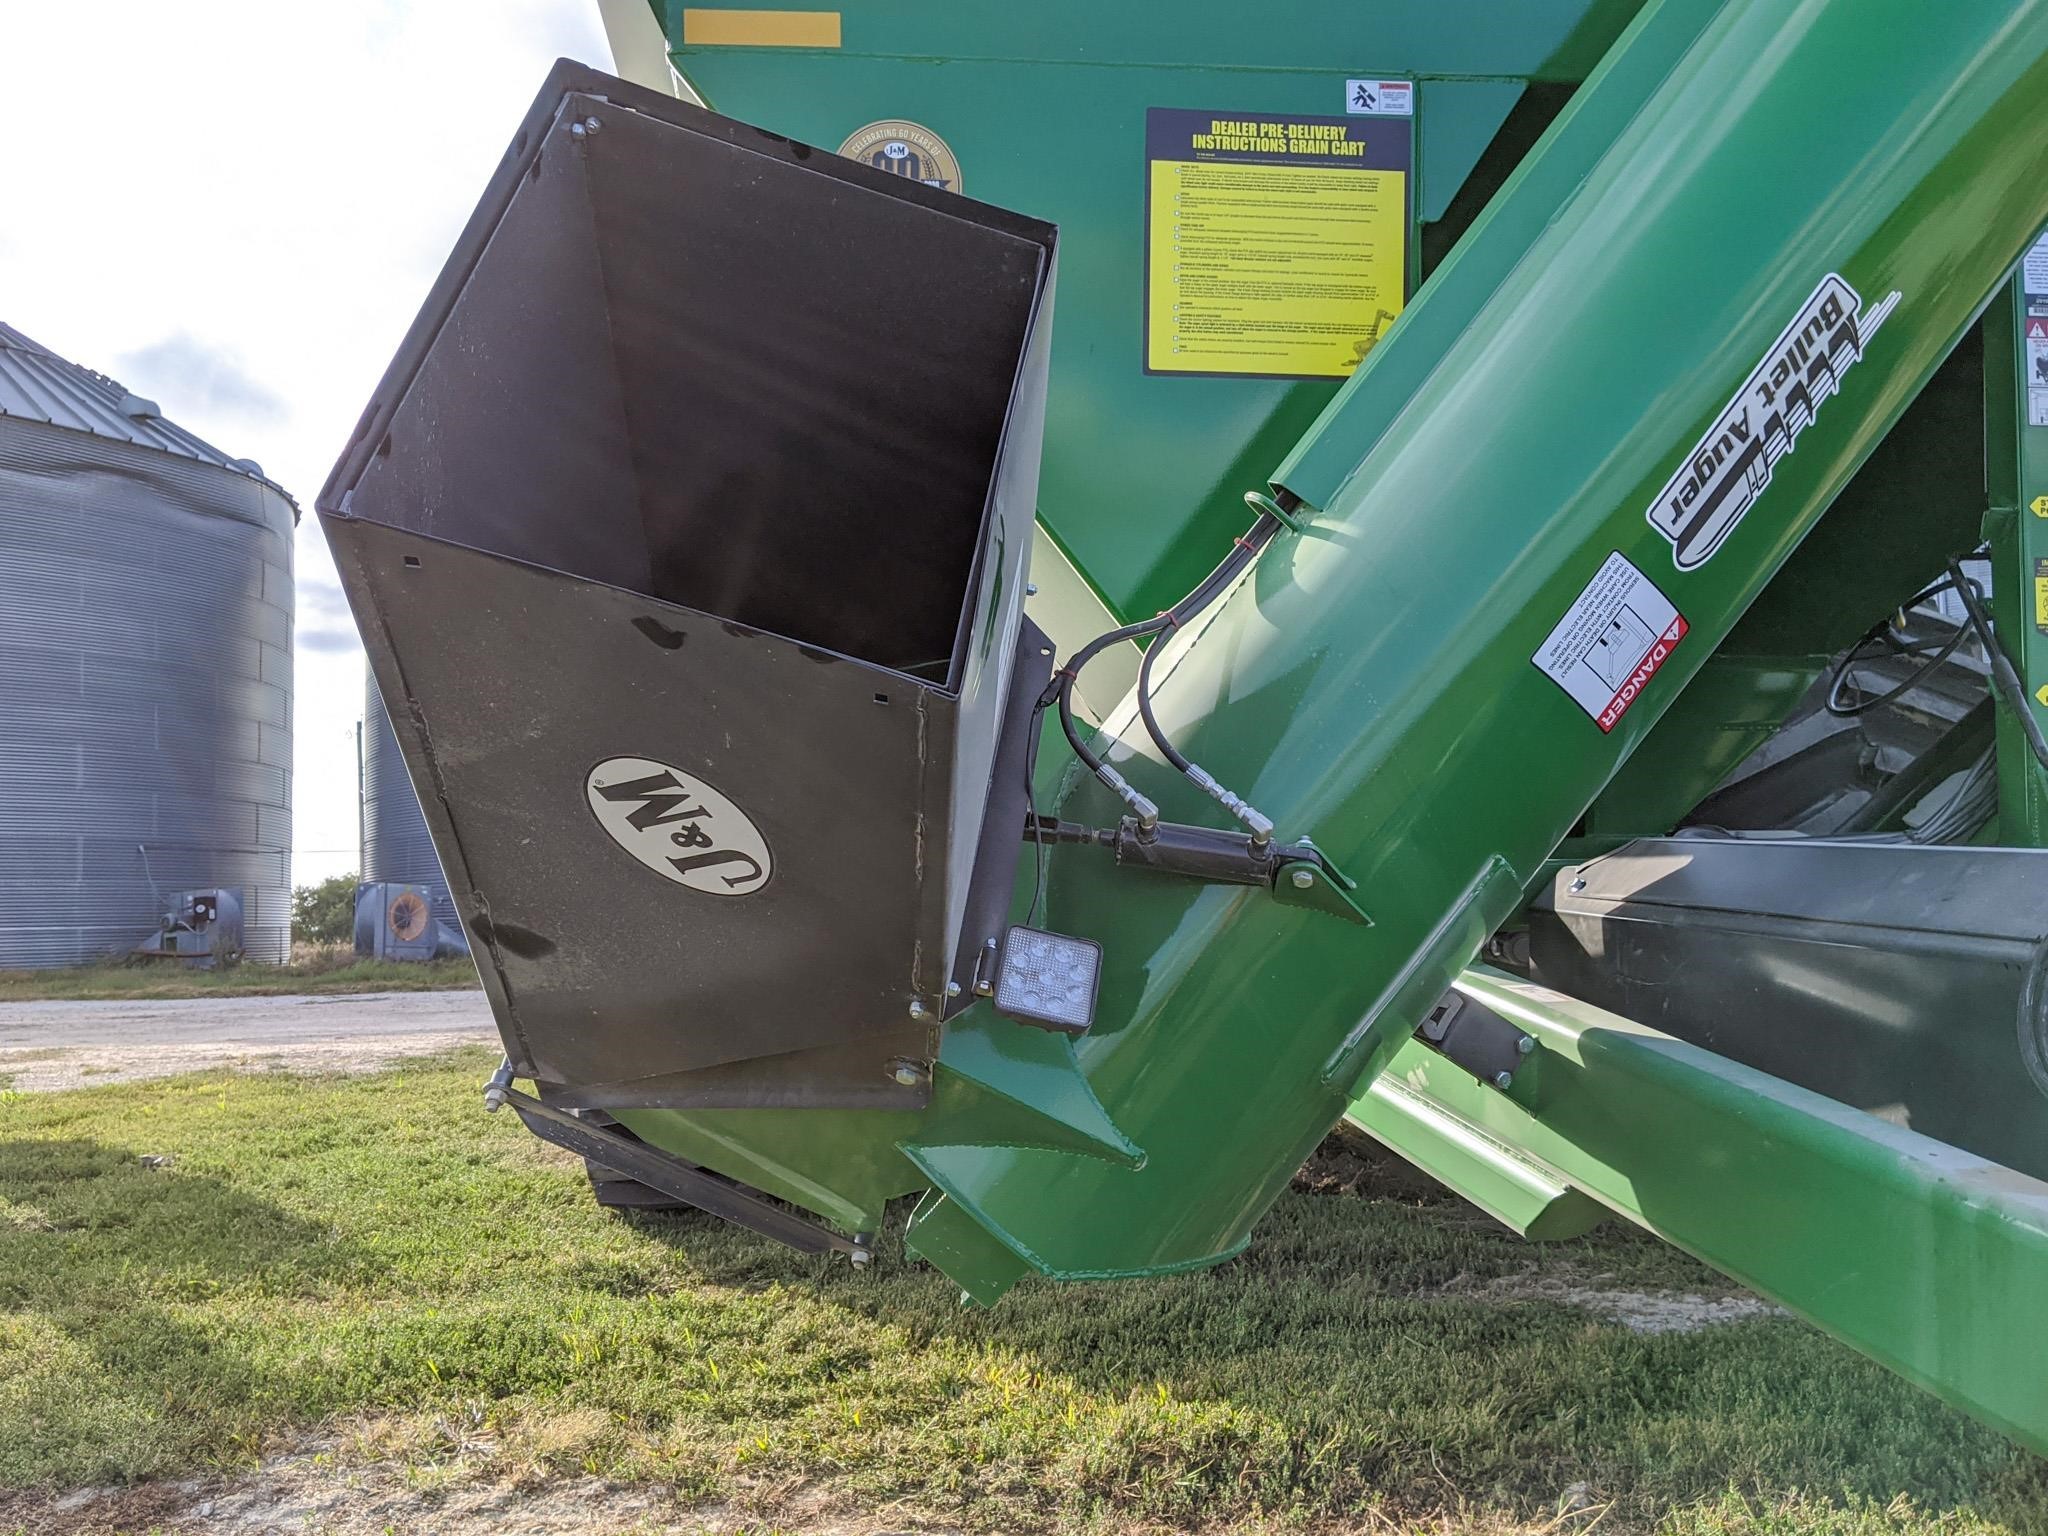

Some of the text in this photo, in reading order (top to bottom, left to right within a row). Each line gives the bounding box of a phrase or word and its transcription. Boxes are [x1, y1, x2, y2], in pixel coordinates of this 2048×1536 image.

[1211, 120, 1347, 141] DEALER PRE-DELIVERY
[850, 128, 942, 157] CELEBRATING 60 YEARS OF
[888, 146, 905, 156] J&M
[1192, 134, 1366, 156] INSTRUCTIONS GRAIN CART
[1669, 291, 1845, 526] Bullet Auger
[1610, 557, 1617, 566] TO
[1612, 561, 1623, 575] THIS
[1597, 565, 1611, 582] AVOID
[1620, 571, 1634, 588] FROM
[1593, 574, 1613, 600] MACHINE
[1620, 576, 1639, 600] SERIOUS
[1581, 599, 1594, 615] NEAR
[1601, 587, 1622, 613] CONTACT
[1548, 566, 1628, 671] USE CARE WHEN MOVING OR OPERATING
[1561, 614, 1583, 641] ELECTRIC
[1590, 612, 1602, 627] WITH
[1570, 627, 1591, 653] ELECTRIC
[1585, 627, 1599, 646] DEATH
[1575, 645, 1586, 658] CAN
[1560, 657, 1577, 678] RESULT
[1601, 643, 1667, 727] DANGER
[592, 769, 763, 888] J&M
